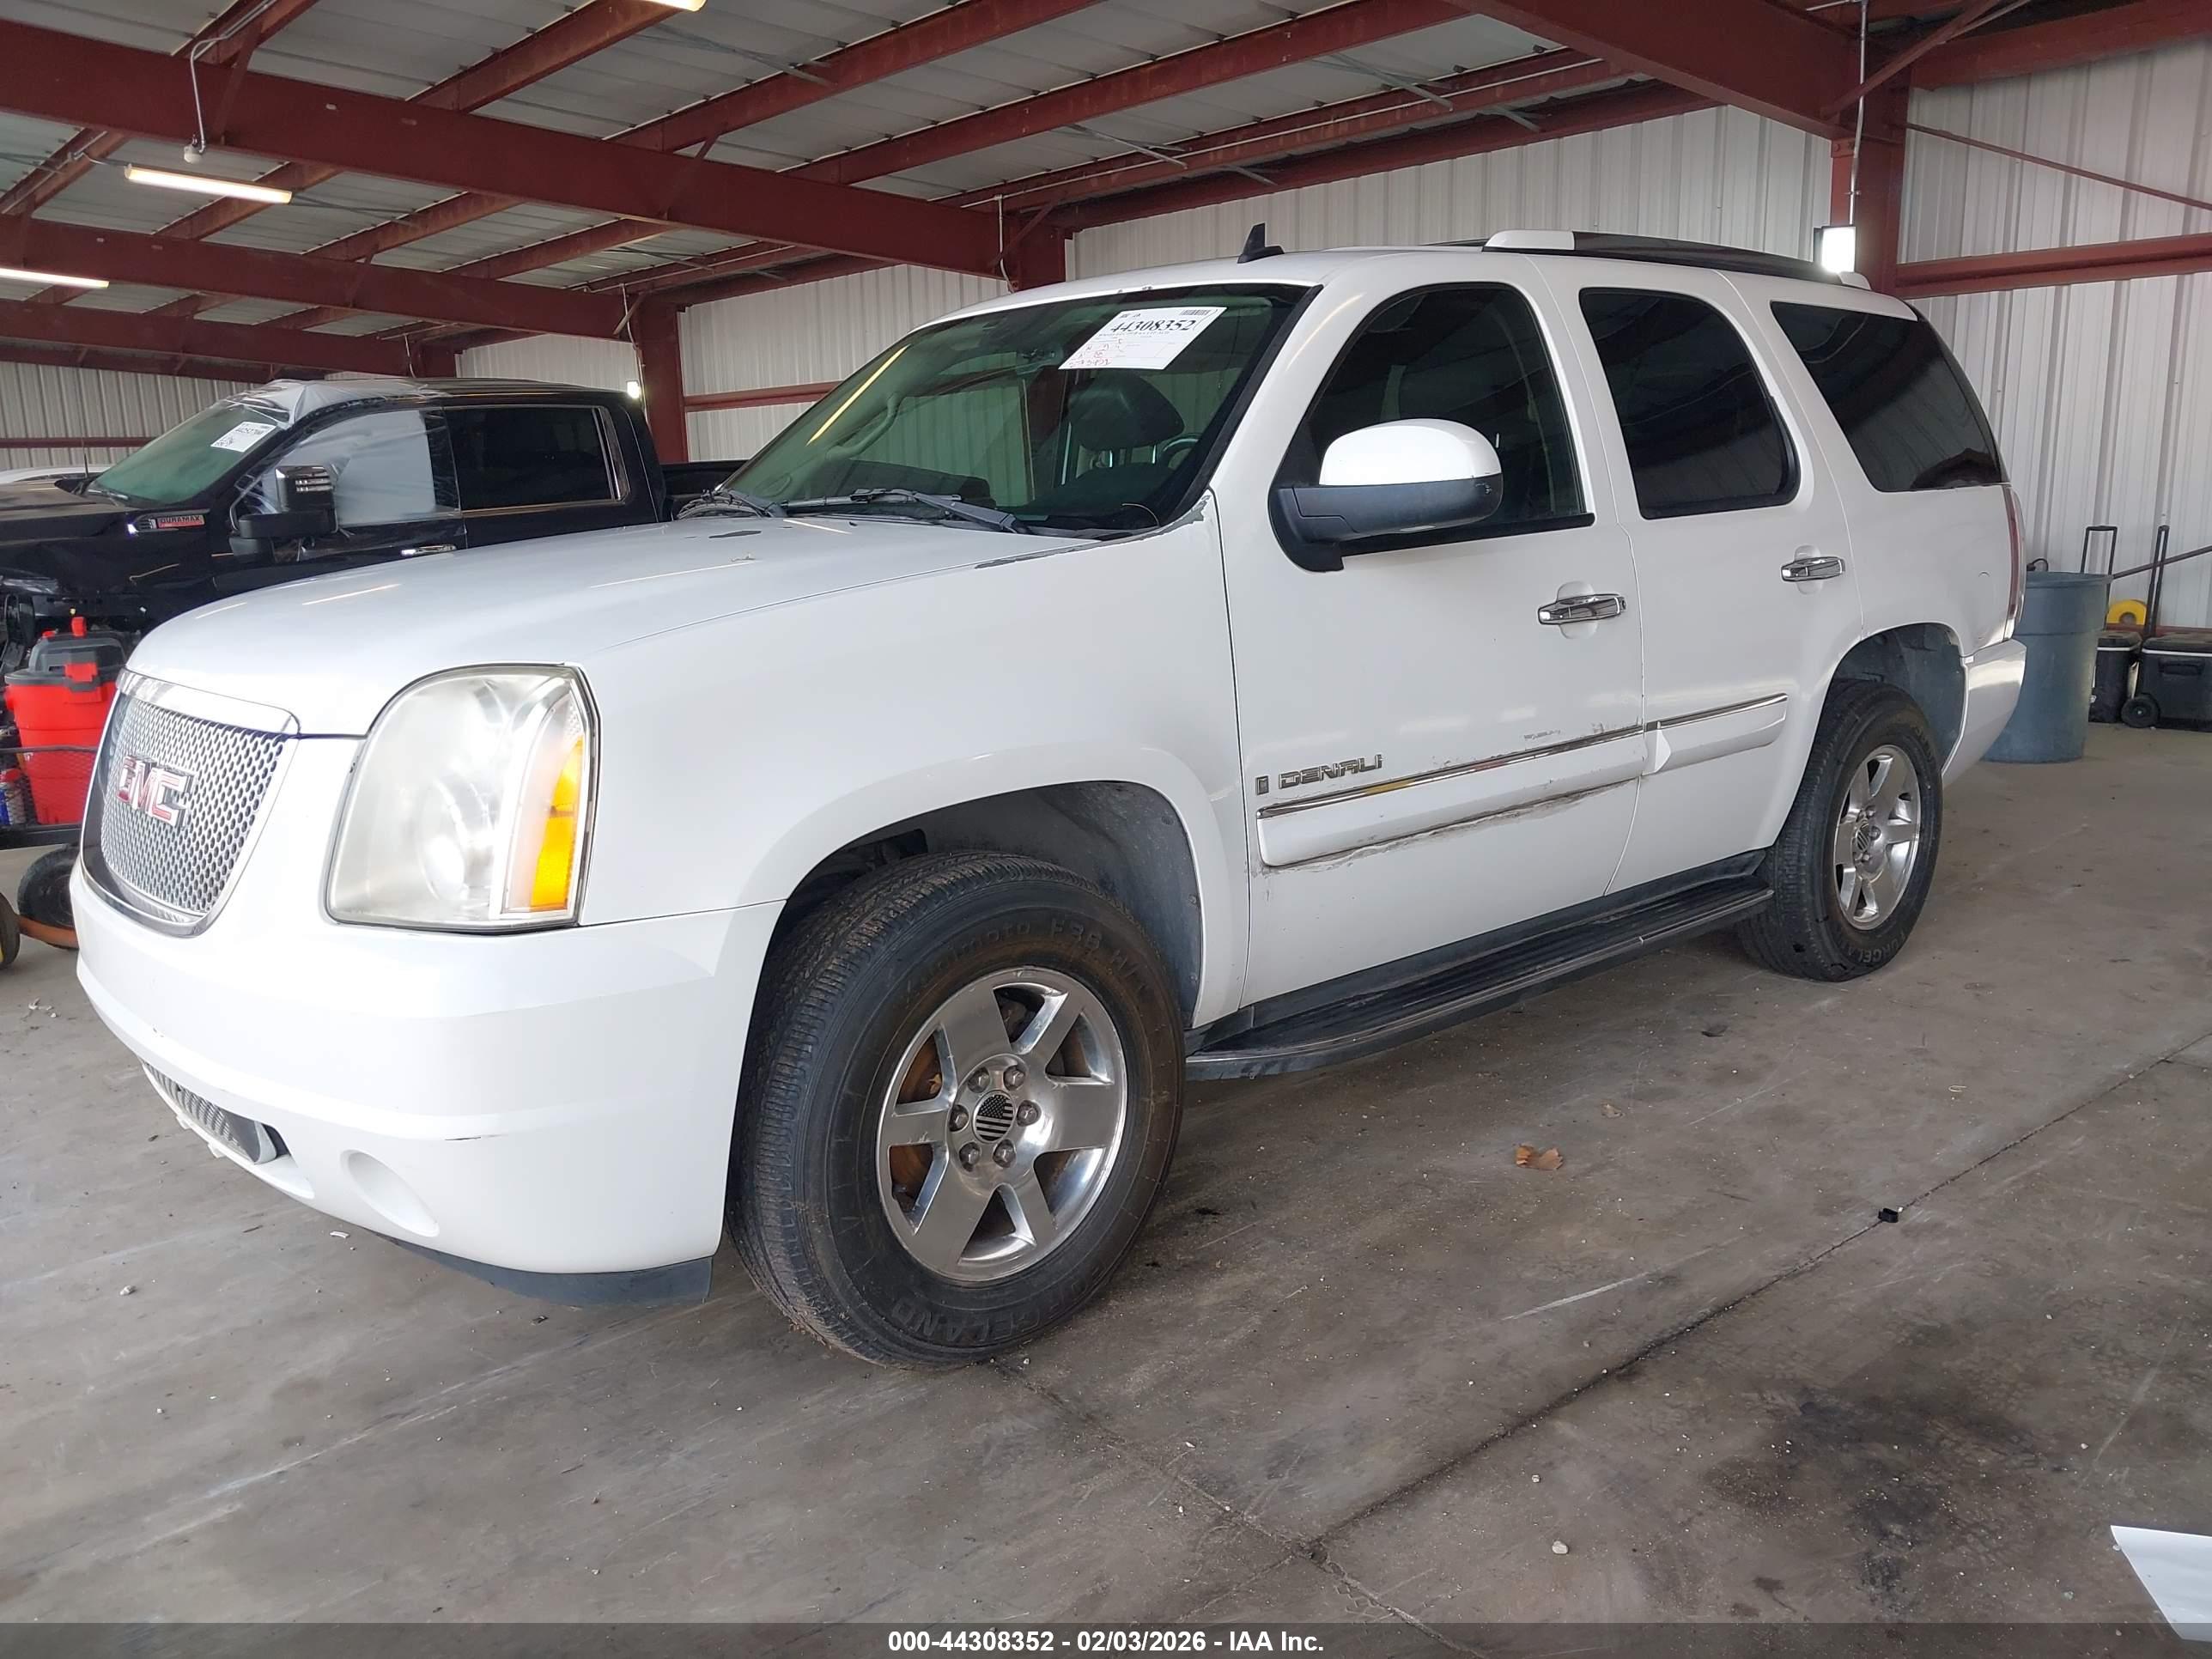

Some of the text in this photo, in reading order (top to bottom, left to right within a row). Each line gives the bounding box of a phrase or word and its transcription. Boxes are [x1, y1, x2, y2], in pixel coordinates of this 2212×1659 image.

[1110, 319, 1196, 332] 44308352
[1279, 754, 1382, 789] DENALI
[116, 756, 191, 826] GMC
